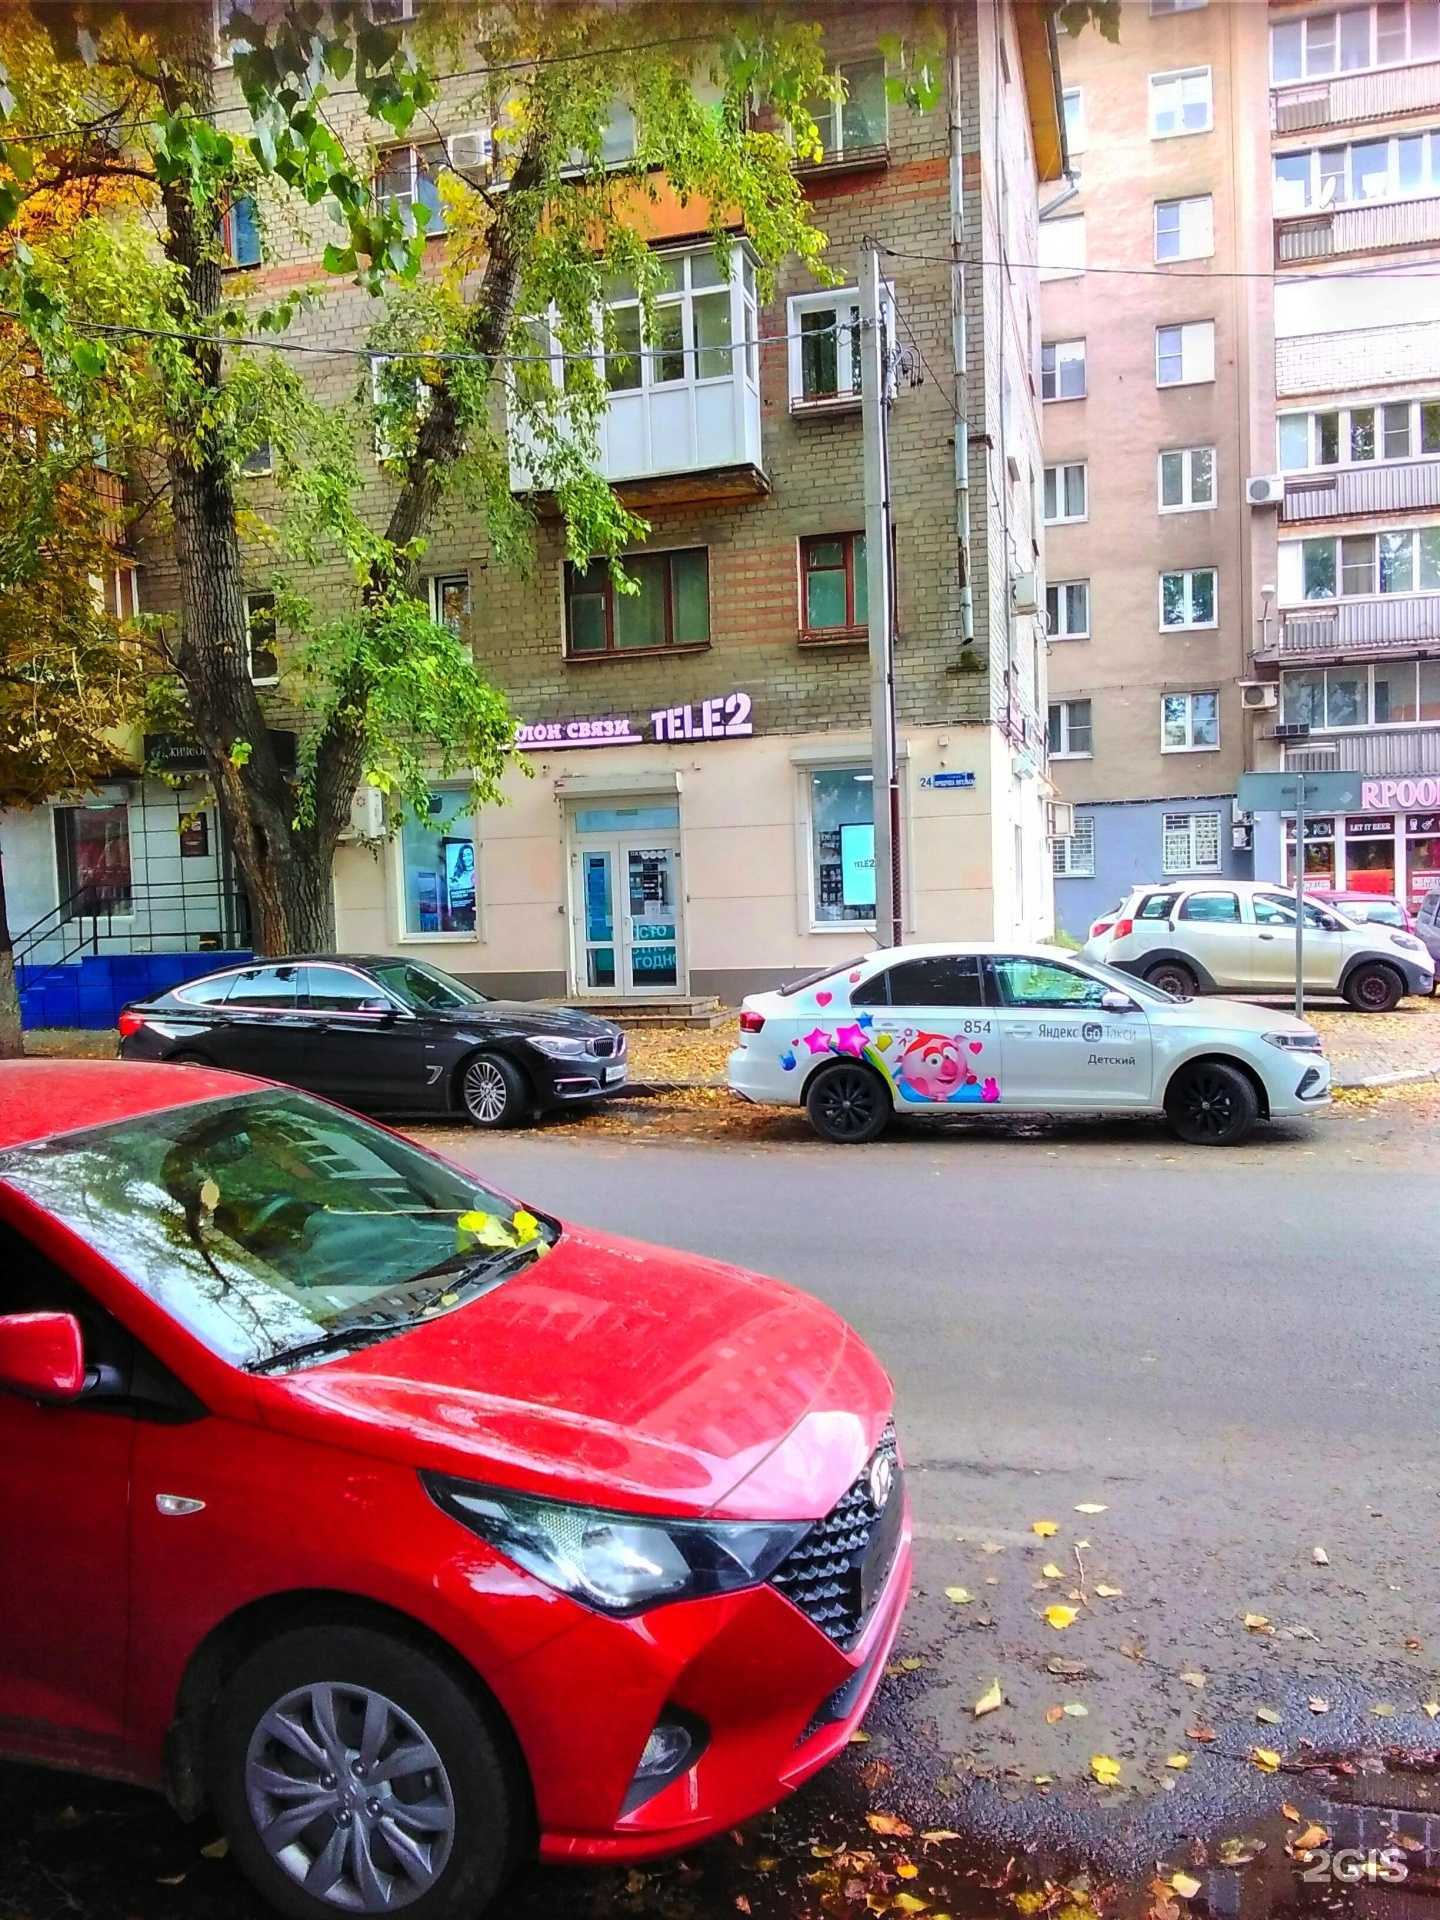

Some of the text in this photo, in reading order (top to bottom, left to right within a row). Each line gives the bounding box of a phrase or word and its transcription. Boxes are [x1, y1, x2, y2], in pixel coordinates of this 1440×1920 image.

[651, 692, 753, 740] TELE2
[516, 719, 630, 742] ЛОН СВЯЗИ
[1361, 778, 1440, 809] RPOO
[963, 1020, 992, 1034] 854
[1038, 1023, 1136, 1040] Яндекс Go Такси
[1087, 1054, 1136, 1065] Детский
